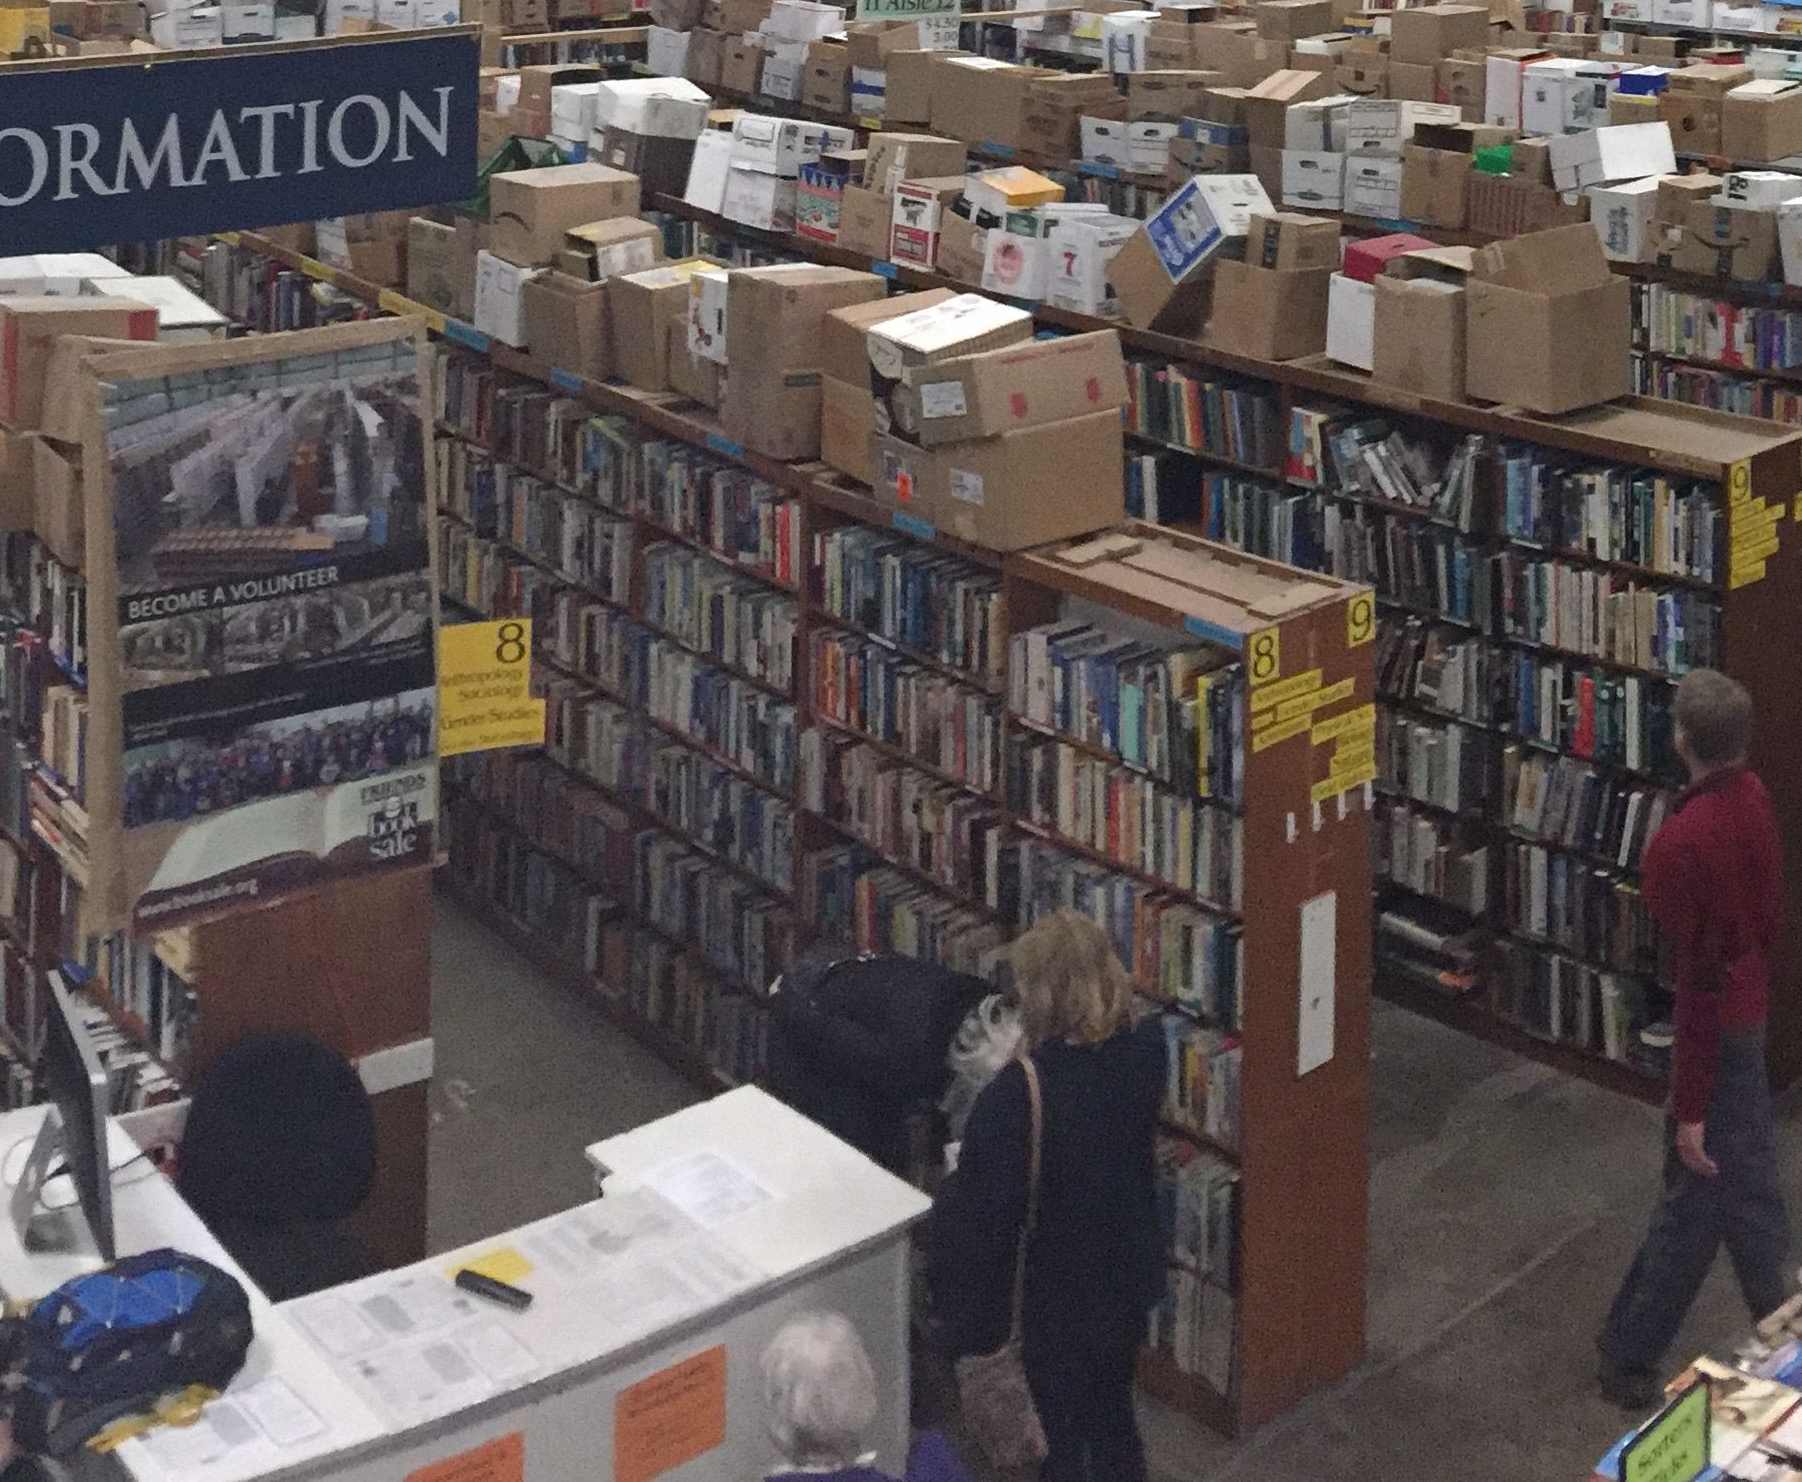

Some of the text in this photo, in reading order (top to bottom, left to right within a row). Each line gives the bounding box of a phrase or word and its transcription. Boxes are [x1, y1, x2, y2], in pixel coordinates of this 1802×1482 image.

[1061, 250, 1075, 277] 7
[1732, 470, 1750, 504] 9
[127, 565, 339, 620] BECOME A VOLUNTEER
[1350, 597, 1372, 641] 9
[494, 622, 526, 664] 8
[1253, 635, 1276, 678] 8
[370, 833, 416, 859] sale
